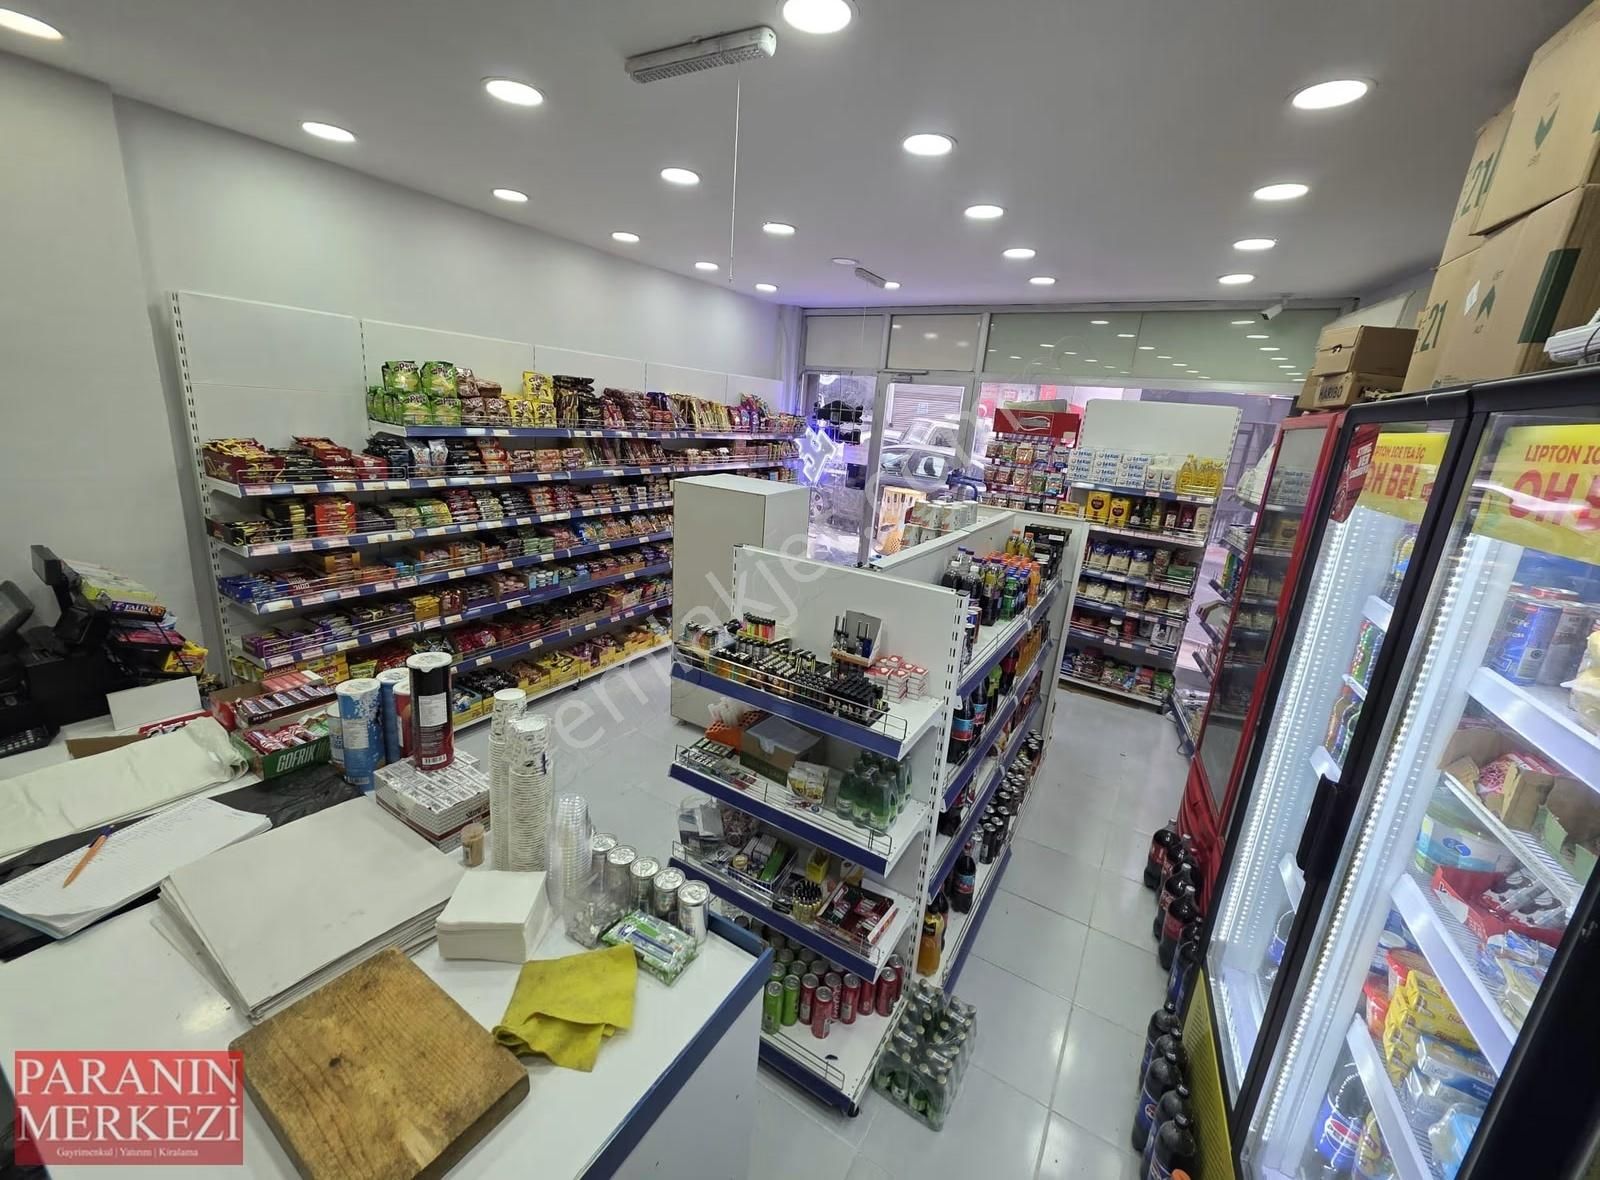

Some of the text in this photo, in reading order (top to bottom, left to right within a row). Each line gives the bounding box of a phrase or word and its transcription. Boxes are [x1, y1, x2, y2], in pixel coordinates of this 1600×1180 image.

[1525, 444, 1583, 464] LIPTON
[1385, 463, 1418, 499] BE!
[276, 744, 317, 773] GOFRIK
